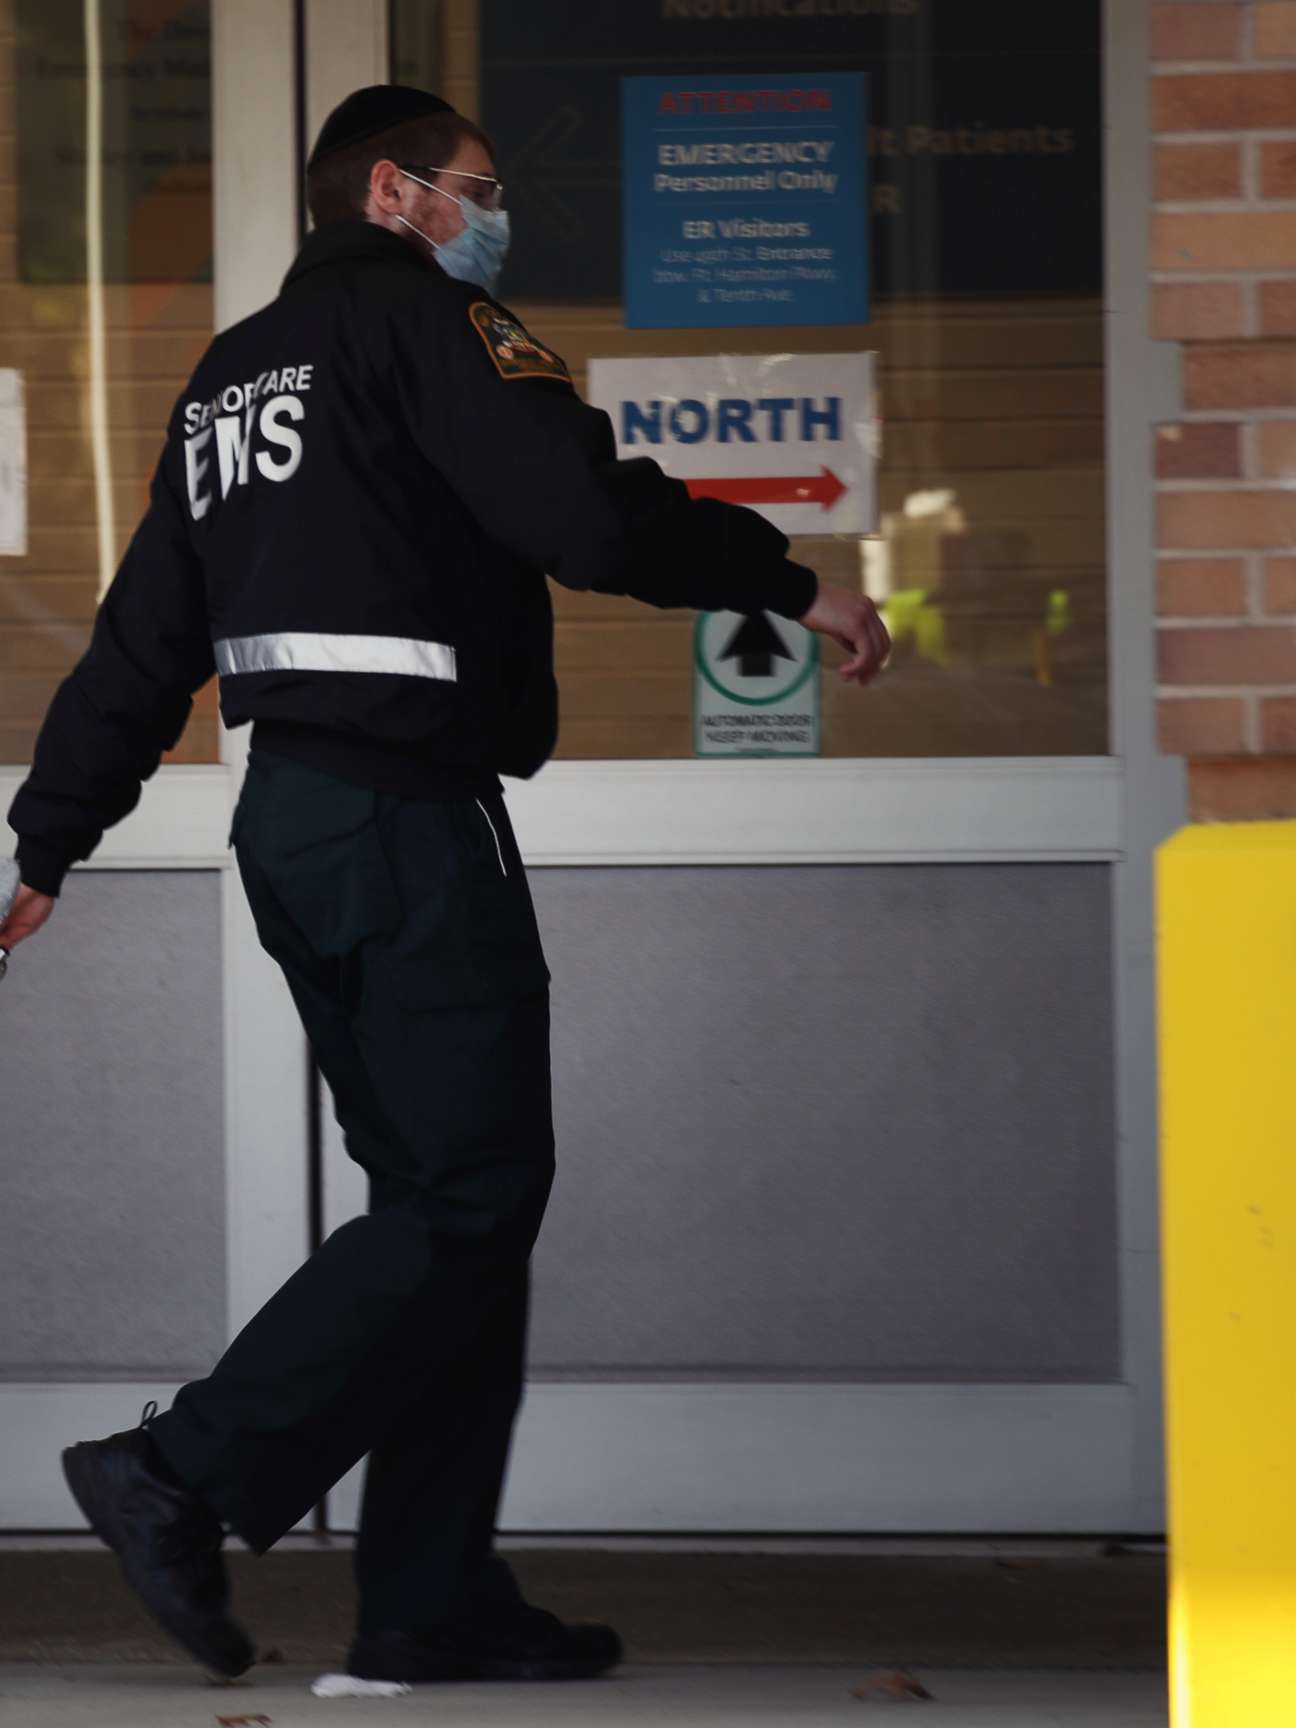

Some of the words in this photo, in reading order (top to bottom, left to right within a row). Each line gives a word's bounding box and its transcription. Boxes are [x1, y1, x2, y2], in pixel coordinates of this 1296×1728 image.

[657, 90, 833, 114] ATTENTION
[905, 124, 1074, 154] Patients
[657, 140, 835, 165] EMERGENCY
[653, 169, 775, 192] Personnel
[778, 169, 838, 194] Only
[682, 219, 715, 239] ER
[717, 217, 811, 239] Visitors
[620, 397, 843, 444] NORTH
[183, 394, 305, 521] EMS
